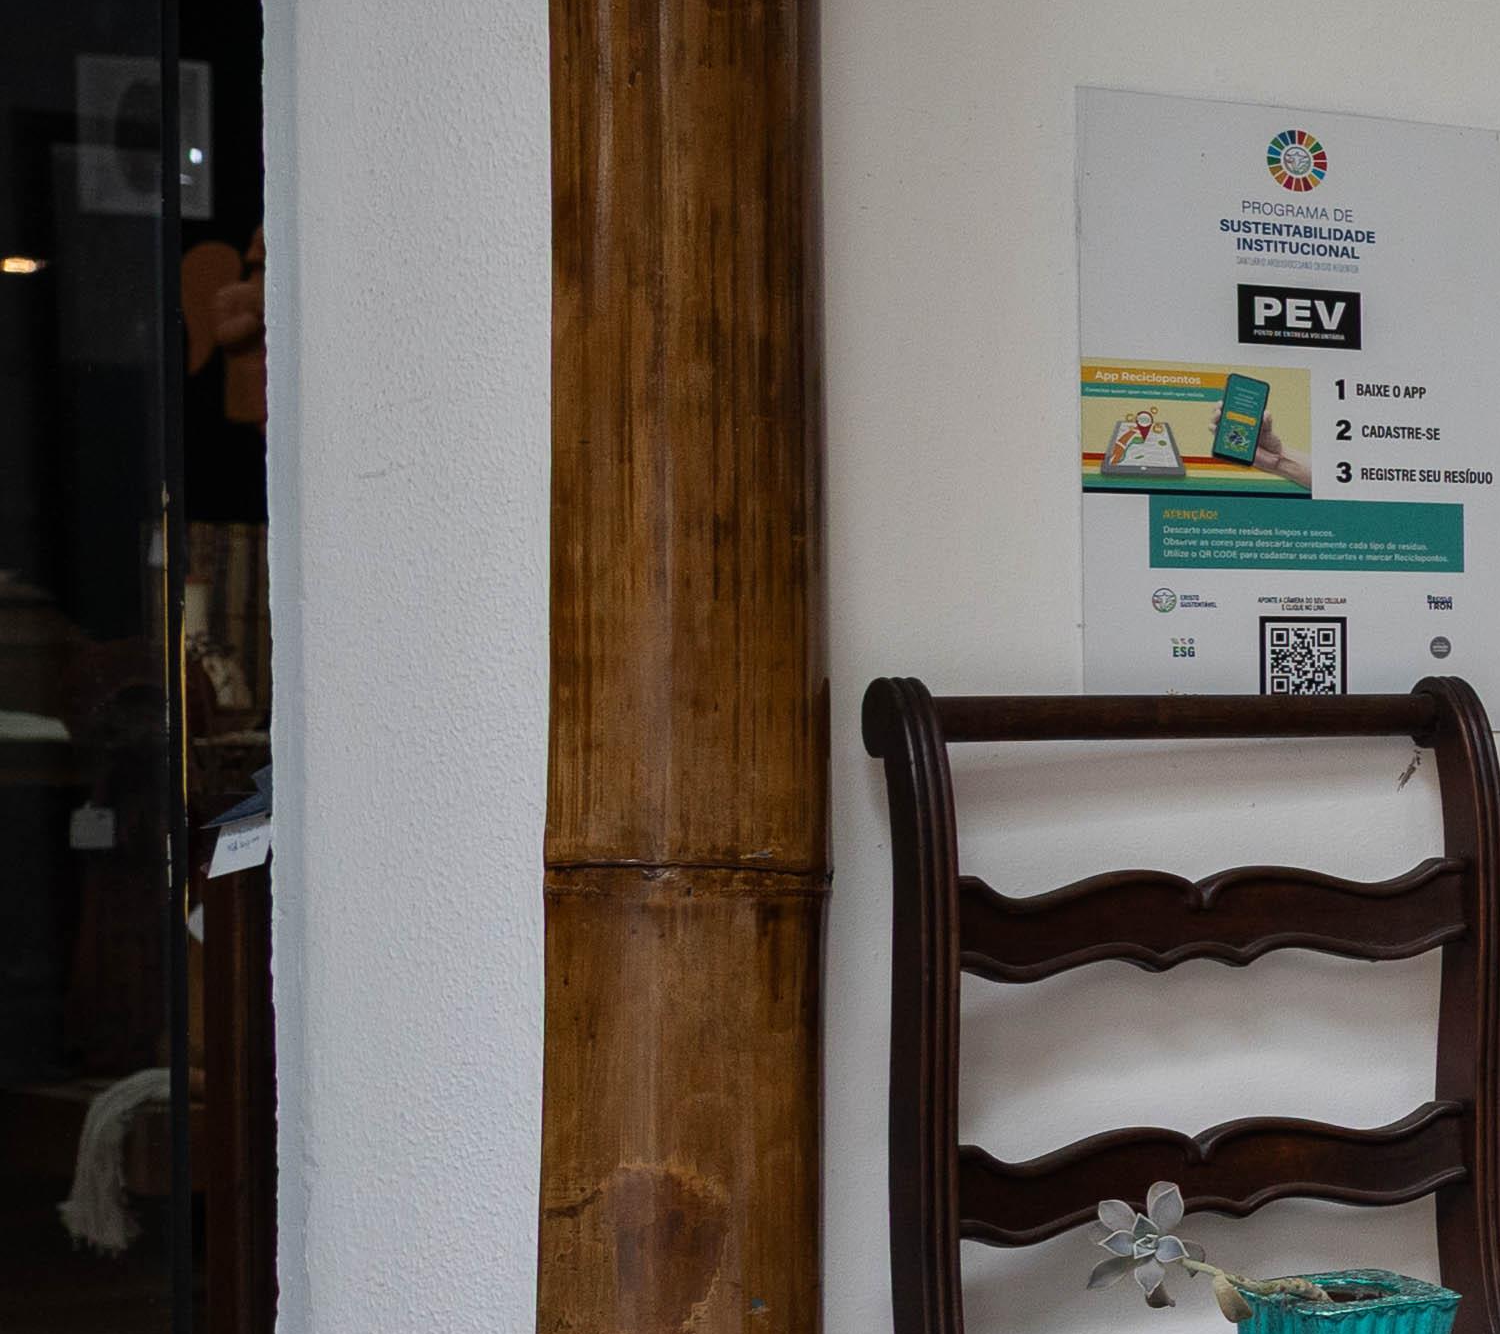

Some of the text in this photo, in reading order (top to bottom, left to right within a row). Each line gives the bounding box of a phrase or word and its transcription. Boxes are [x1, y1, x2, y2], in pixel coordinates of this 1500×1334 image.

[1242, 201, 1353, 222] PROGRAMA DE
[1219, 219, 1376, 243] SUSTENTABILIDADE
[1237, 238, 1360, 259] INSTITUCIONAL
[1254, 296, 1346, 330] PEV
[1095, 371, 1201, 385] App Reciclopontos
[1335, 379, 1426, 400] 1 BAIXE O APP
[1336, 420, 1440, 441] 2 CADASTRE-SE
[1336, 462, 1493, 484] 3 REGISTRE SEU RESÍDUO
[1213, 550, 1237, 559] CODE
[1173, 646, 1195, 657] ESG
